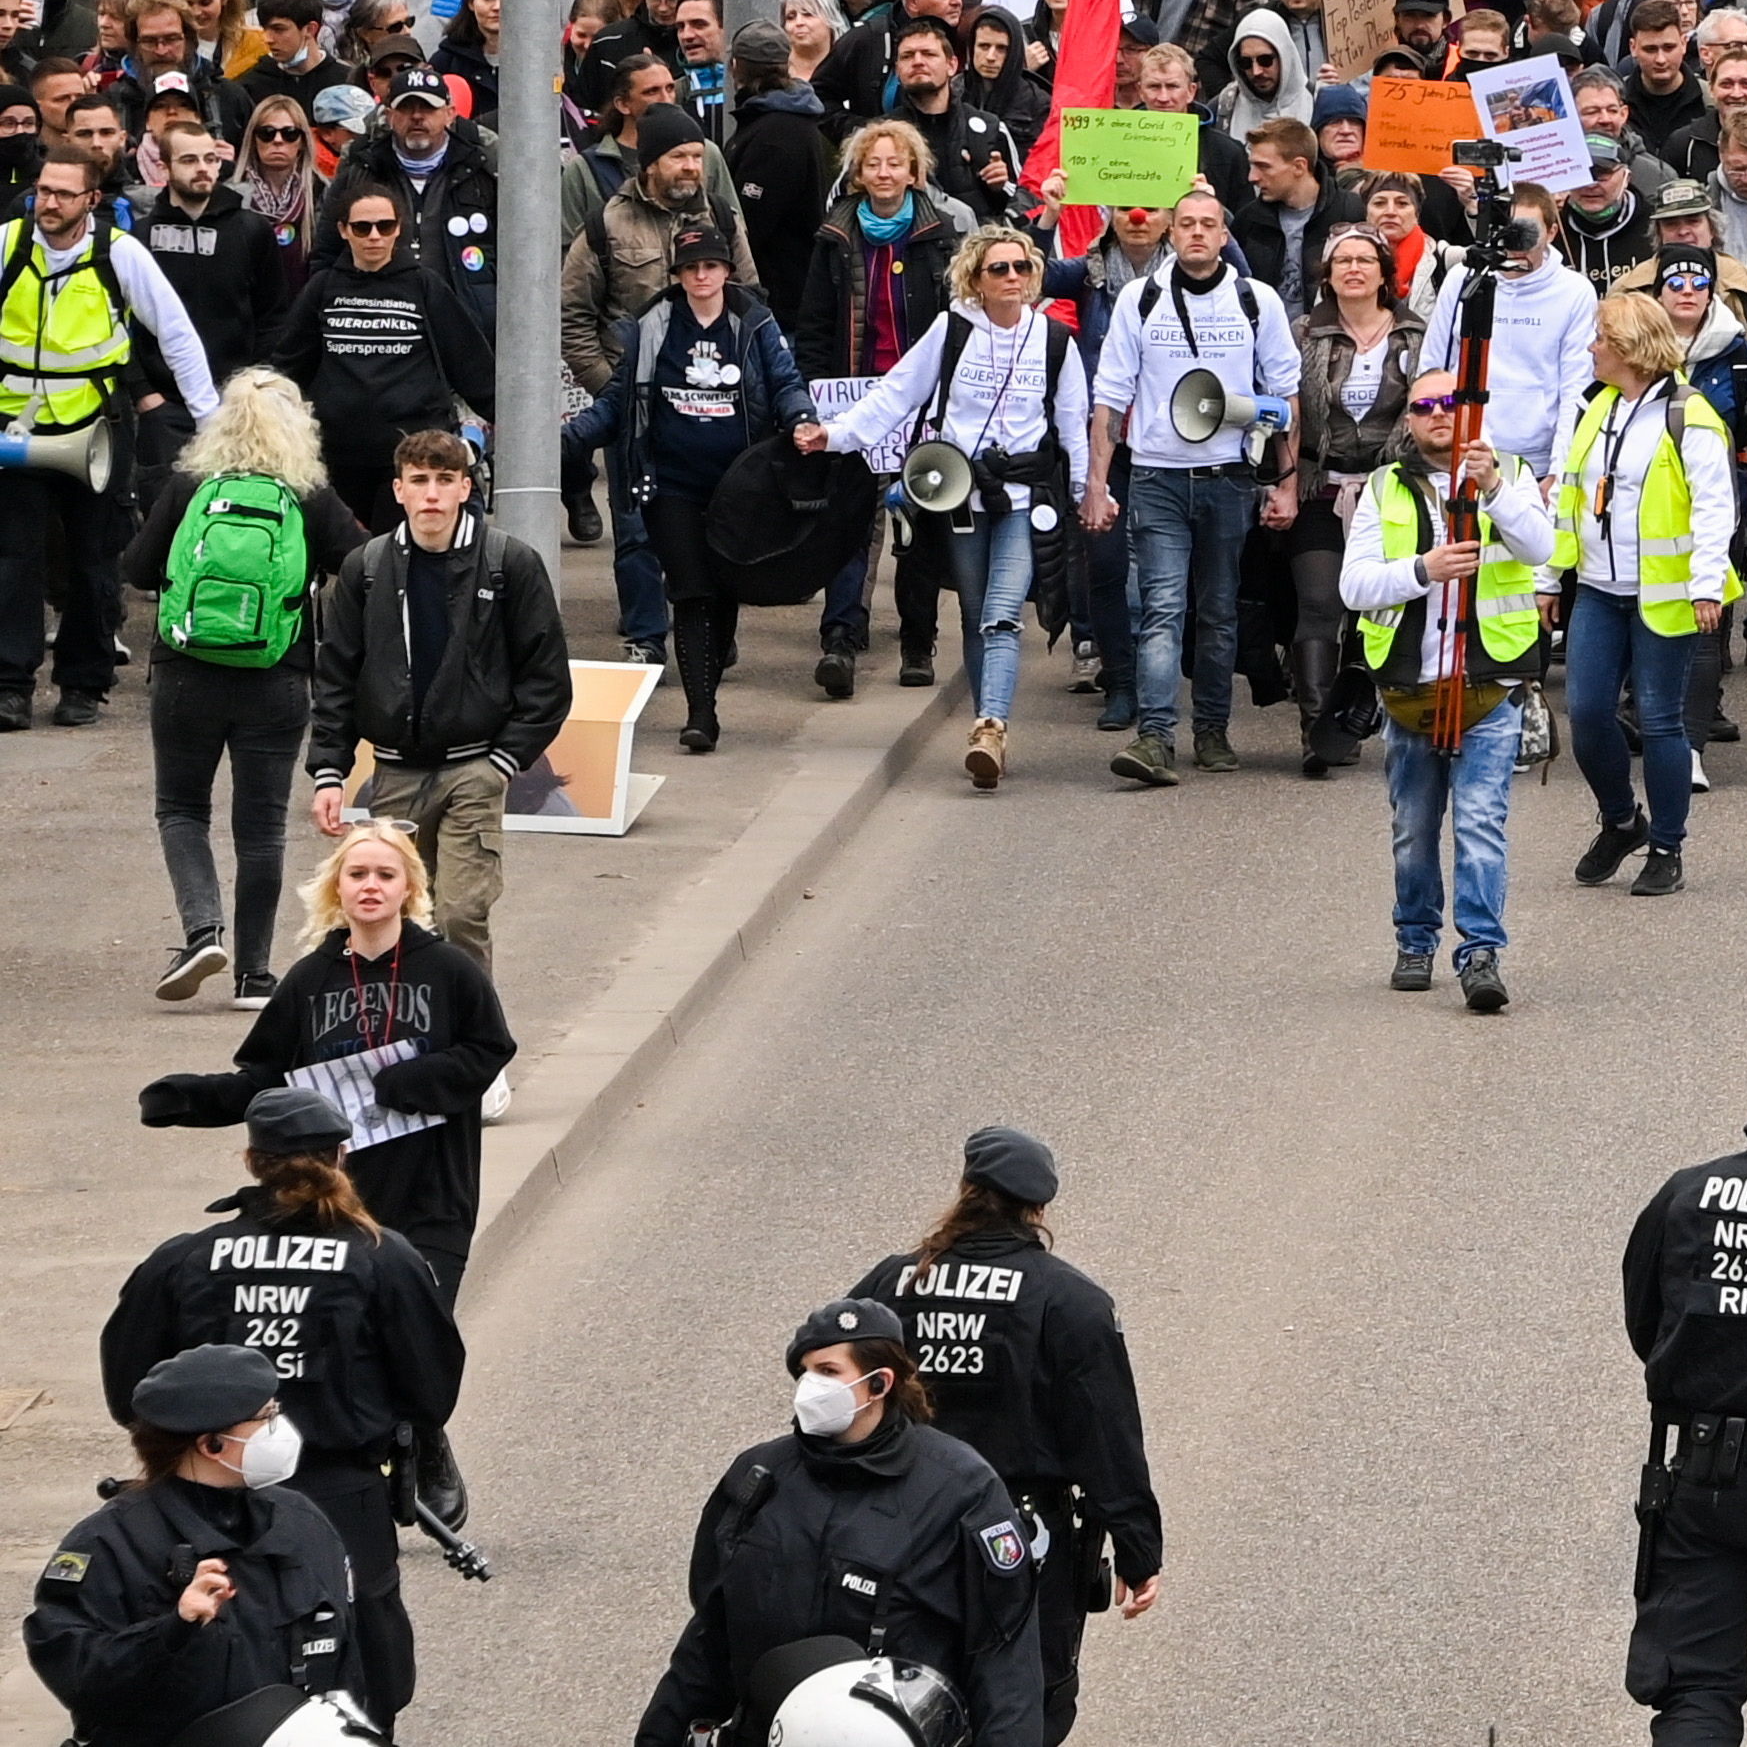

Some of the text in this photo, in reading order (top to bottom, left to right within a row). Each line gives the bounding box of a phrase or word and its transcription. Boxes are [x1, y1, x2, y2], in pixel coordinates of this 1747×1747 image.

[1327, 8, 1350, 36] Top
[1383, 81, 1413, 101] 75
[326, 339, 413, 356] Superspreader
[1202, 349, 1226, 359] Crew
[1005, 391, 1028, 404] Crew
[307, 981, 432, 1040] LEGENDS
[355, 1013, 381, 1034] OF
[210, 1234, 349, 1272] POLIZEI
[896, 1264, 1024, 1302] POLIZEI
[233, 1283, 312, 1315] NRW
[916, 1312, 986, 1342] NRW
[918, 1345, 985, 1374] 2623
